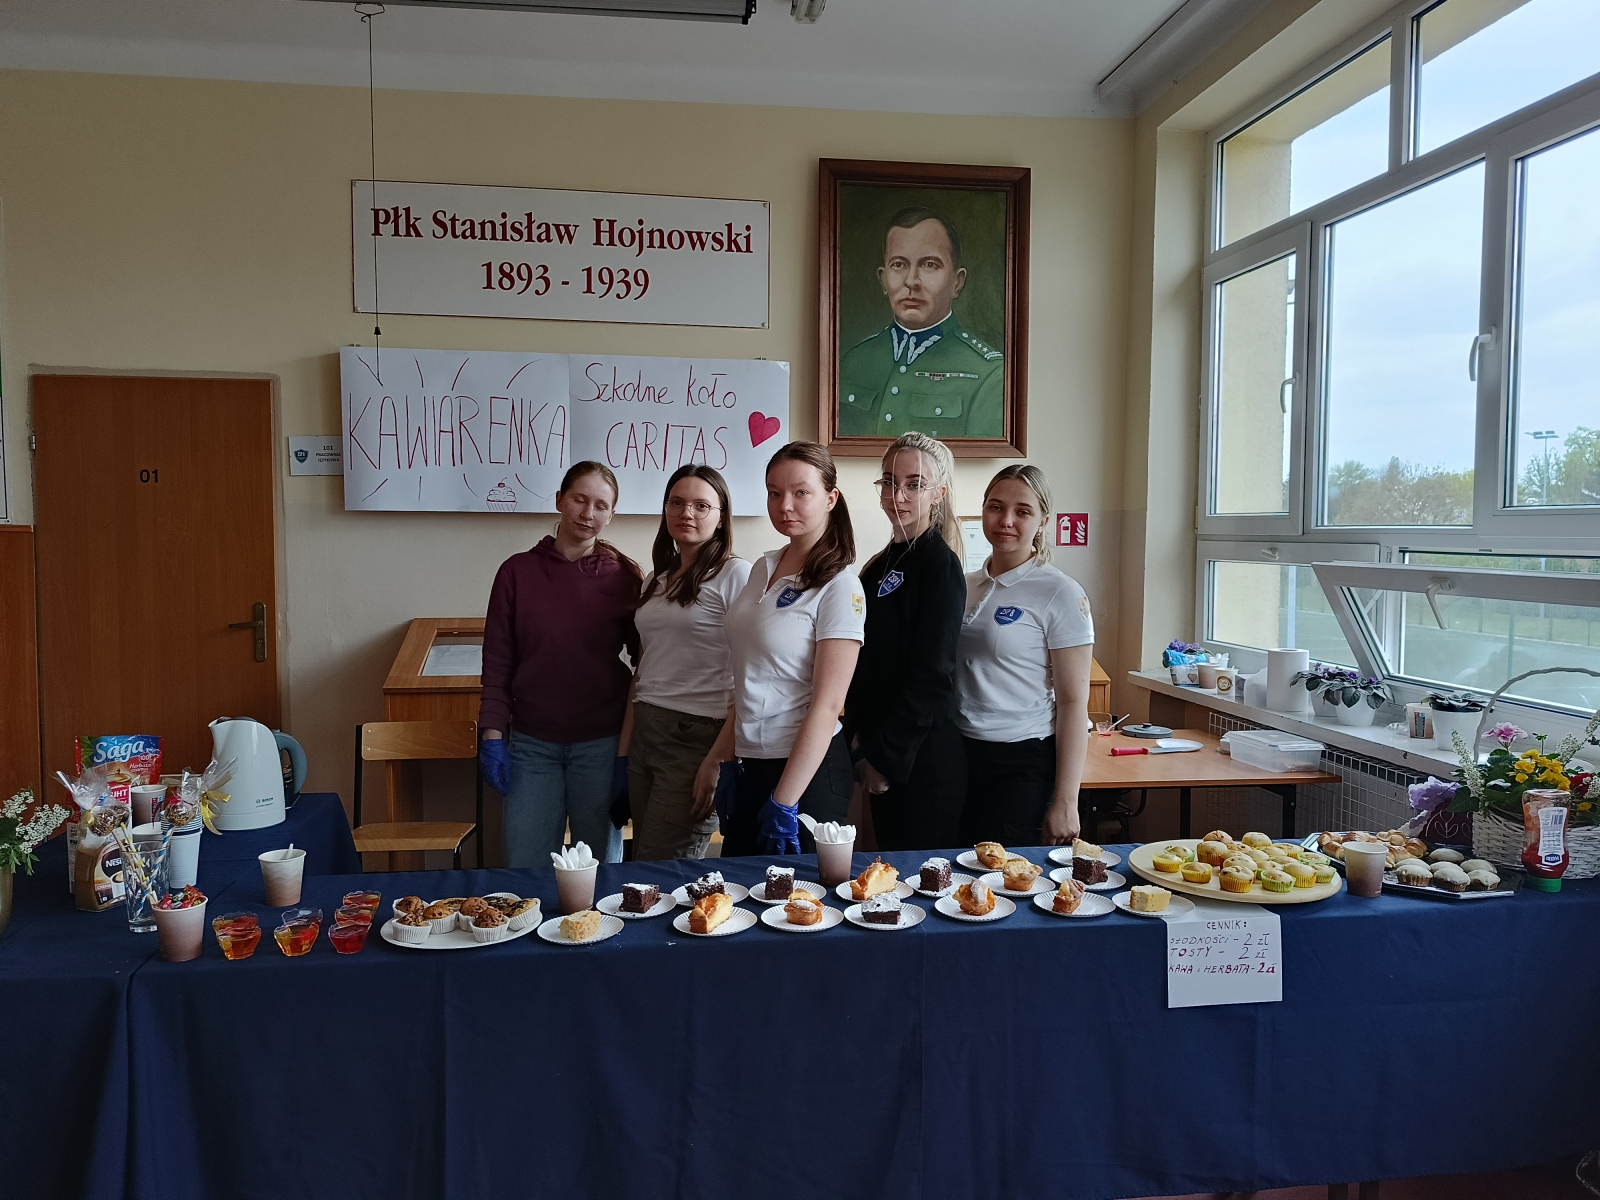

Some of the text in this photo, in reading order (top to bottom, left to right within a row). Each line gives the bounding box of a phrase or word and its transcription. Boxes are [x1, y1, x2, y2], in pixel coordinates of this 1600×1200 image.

[370, 206, 754, 258] Płk Stanisław Hojnowski
[480, 261, 551, 296] 1893
[581, 265, 650, 300] 1939
[578, 362, 674, 405] Szkolne
[605, 421, 728, 472] CARITAS
[140, 469, 159, 484] 01
[93, 740, 145, 763] Saga
[1243, 933, 1253, 946] 2
[1170, 946, 1213, 958] TOSTY
[1238, 946, 1250, 960] 2
[1169, 964, 1193, 974] KAWA
